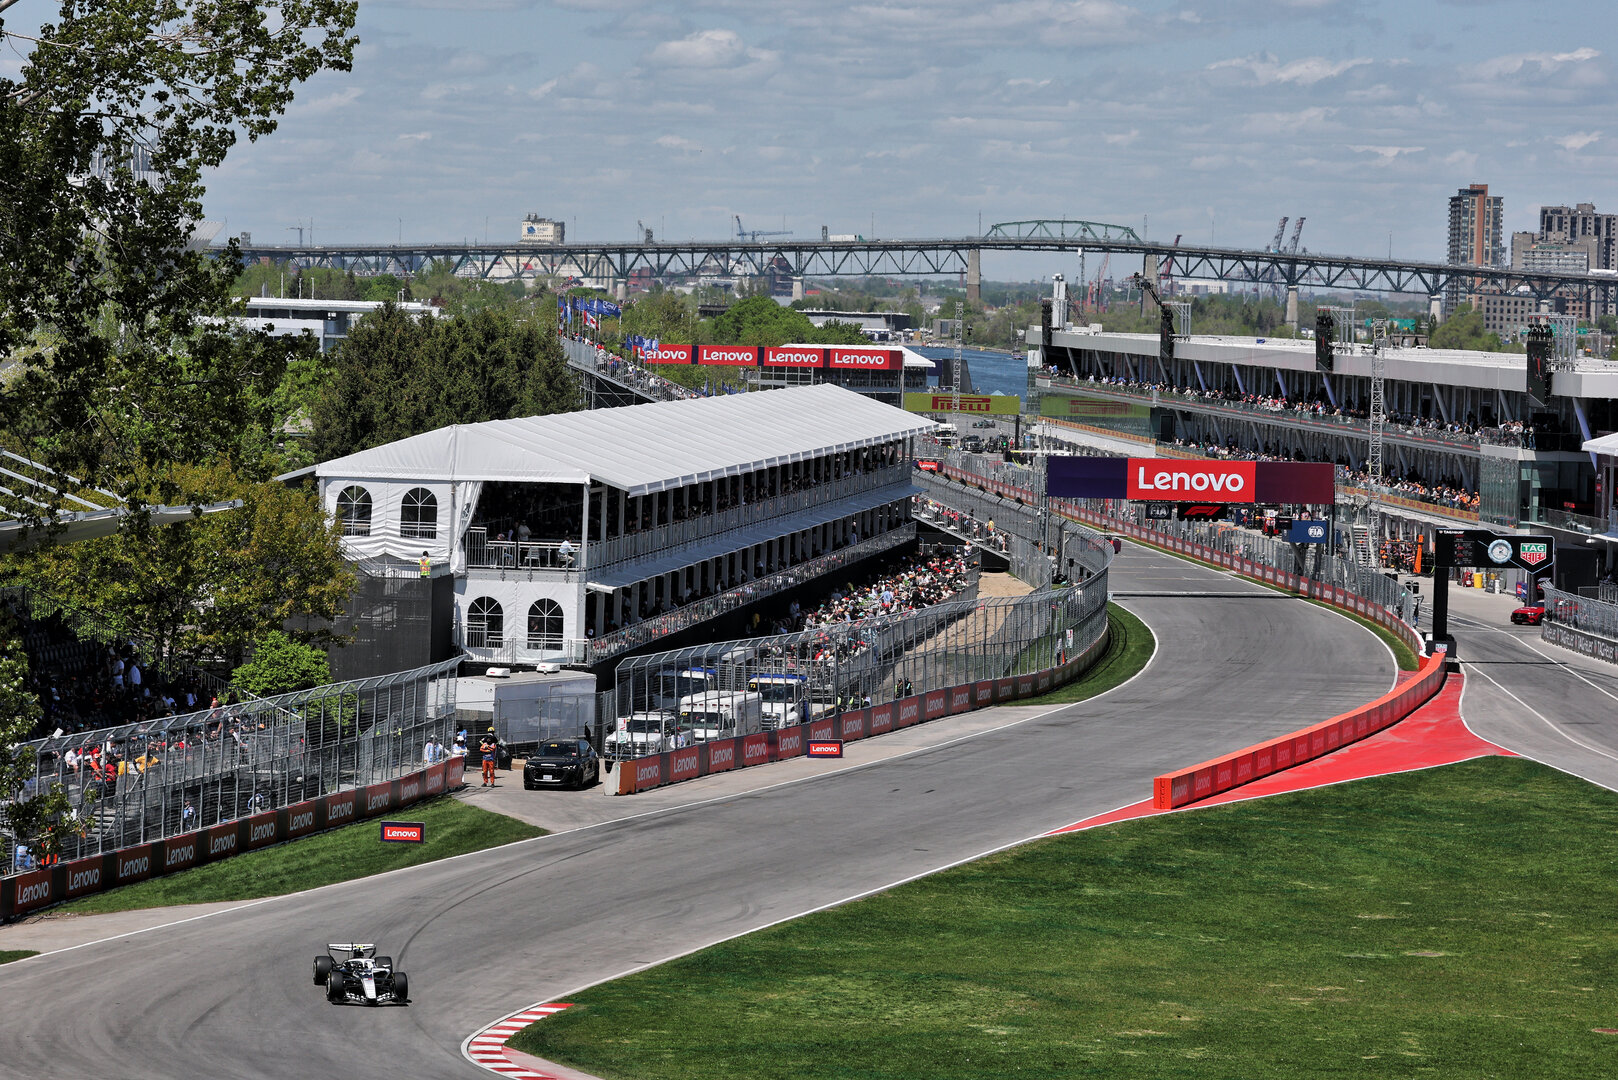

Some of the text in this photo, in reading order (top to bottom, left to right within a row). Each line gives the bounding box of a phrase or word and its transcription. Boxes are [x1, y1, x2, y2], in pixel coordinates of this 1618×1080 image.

[638, 347, 687, 359] Lenovo
[703, 350, 753, 361] Lenovo
[769, 350, 818, 363] Lenovo
[834, 352, 884, 365] Lenovo
[1138, 466, 1244, 492] Lenovo
[1522, 553, 1546, 564] HEUER
[953, 692, 969, 706] Lenovo
[977, 688, 992, 700] Lenovo
[900, 704, 917, 720] Lenovo
[926, 698, 944, 712] Lenovo
[843, 719, 862, 734] Lenovo
[872, 713, 890, 728] Lenovo
[812, 726, 832, 739] Lenovo
[745, 742, 766, 758] Lenovo
[778, 735, 800, 752] Lenovo
[674, 756, 696, 773] Lenovo
[710, 748, 732, 765] Lenovo
[637, 765, 658, 781] Lenovo
[402, 782, 418, 800] Lenovo
[1172, 784, 1188, 798] Lenovo
[1196, 776, 1210, 790] Lenovo
[368, 792, 390, 810] Lenovo
[328, 802, 352, 820] Lenovo
[290, 812, 312, 831] Lenovo
[250, 822, 274, 841] Lenovo
[387, 829, 418, 838] Lenovo
[210, 833, 236, 853] Lenovo
[166, 844, 194, 866] Lenovo
[120, 856, 148, 878] Lenovo
[68, 868, 100, 890] Lenovo
[18, 881, 49, 904] Lenovo
